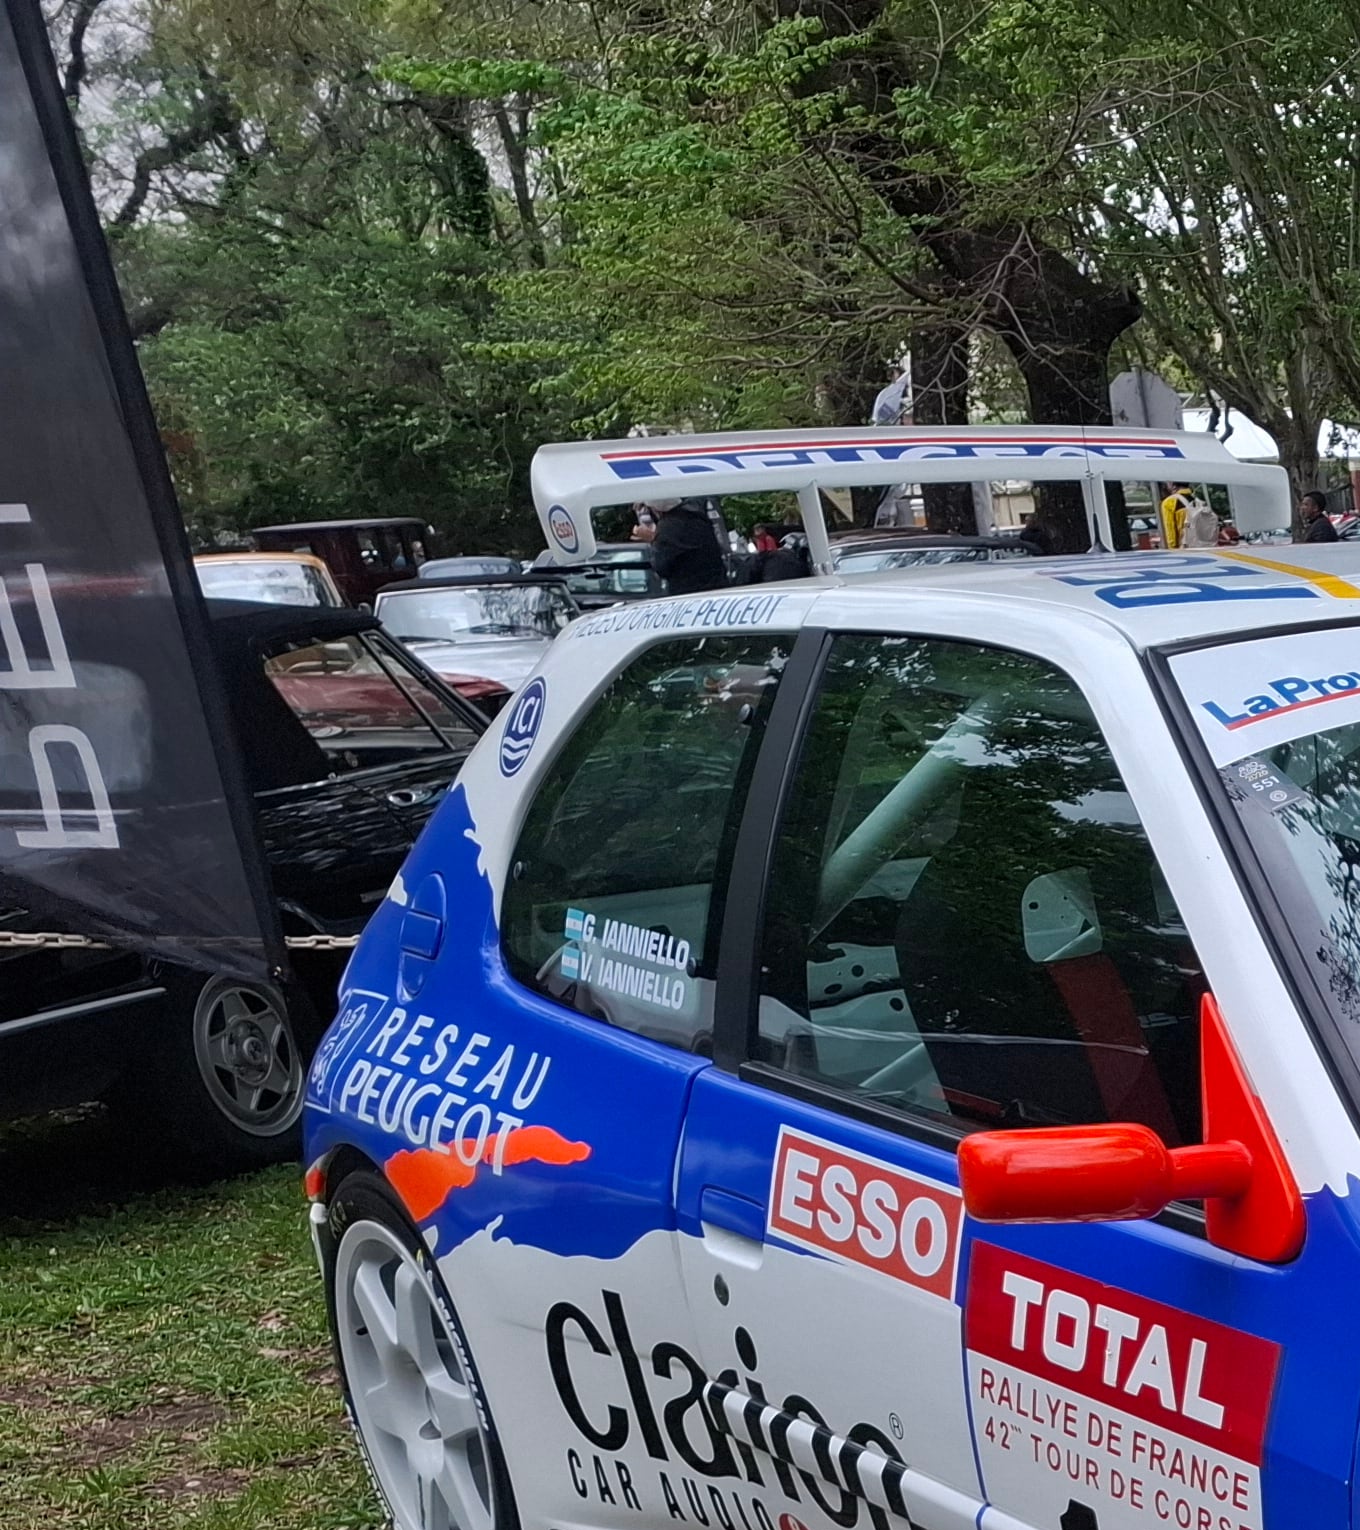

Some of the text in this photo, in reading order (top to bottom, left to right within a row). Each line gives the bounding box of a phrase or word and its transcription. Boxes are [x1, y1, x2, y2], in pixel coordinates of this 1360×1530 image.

[690, 594, 789, 627] PEUGEOT
[513, 697, 541, 737] ICI
[1201, 693, 1278, 726] La
[1251, 775, 1280, 792] 551
[582, 913, 690, 970] G. IANNIELLO
[580, 951, 685, 1010] V. IANNIELLO
[366, 1006, 551, 1110] RESEAU
[340, 1058, 525, 1176] PEUGEOT
[778, 1147, 949, 1278] ESSO
[1002, 1270, 1225, 1430] TOTAL
[980, 1368, 1250, 1511] RALLYE DE FRANCE
[567, 1448, 643, 1512] CAR
[1030, 1434, 1100, 1490] TOUR
[1110, 1469, 1144, 1510] DE
